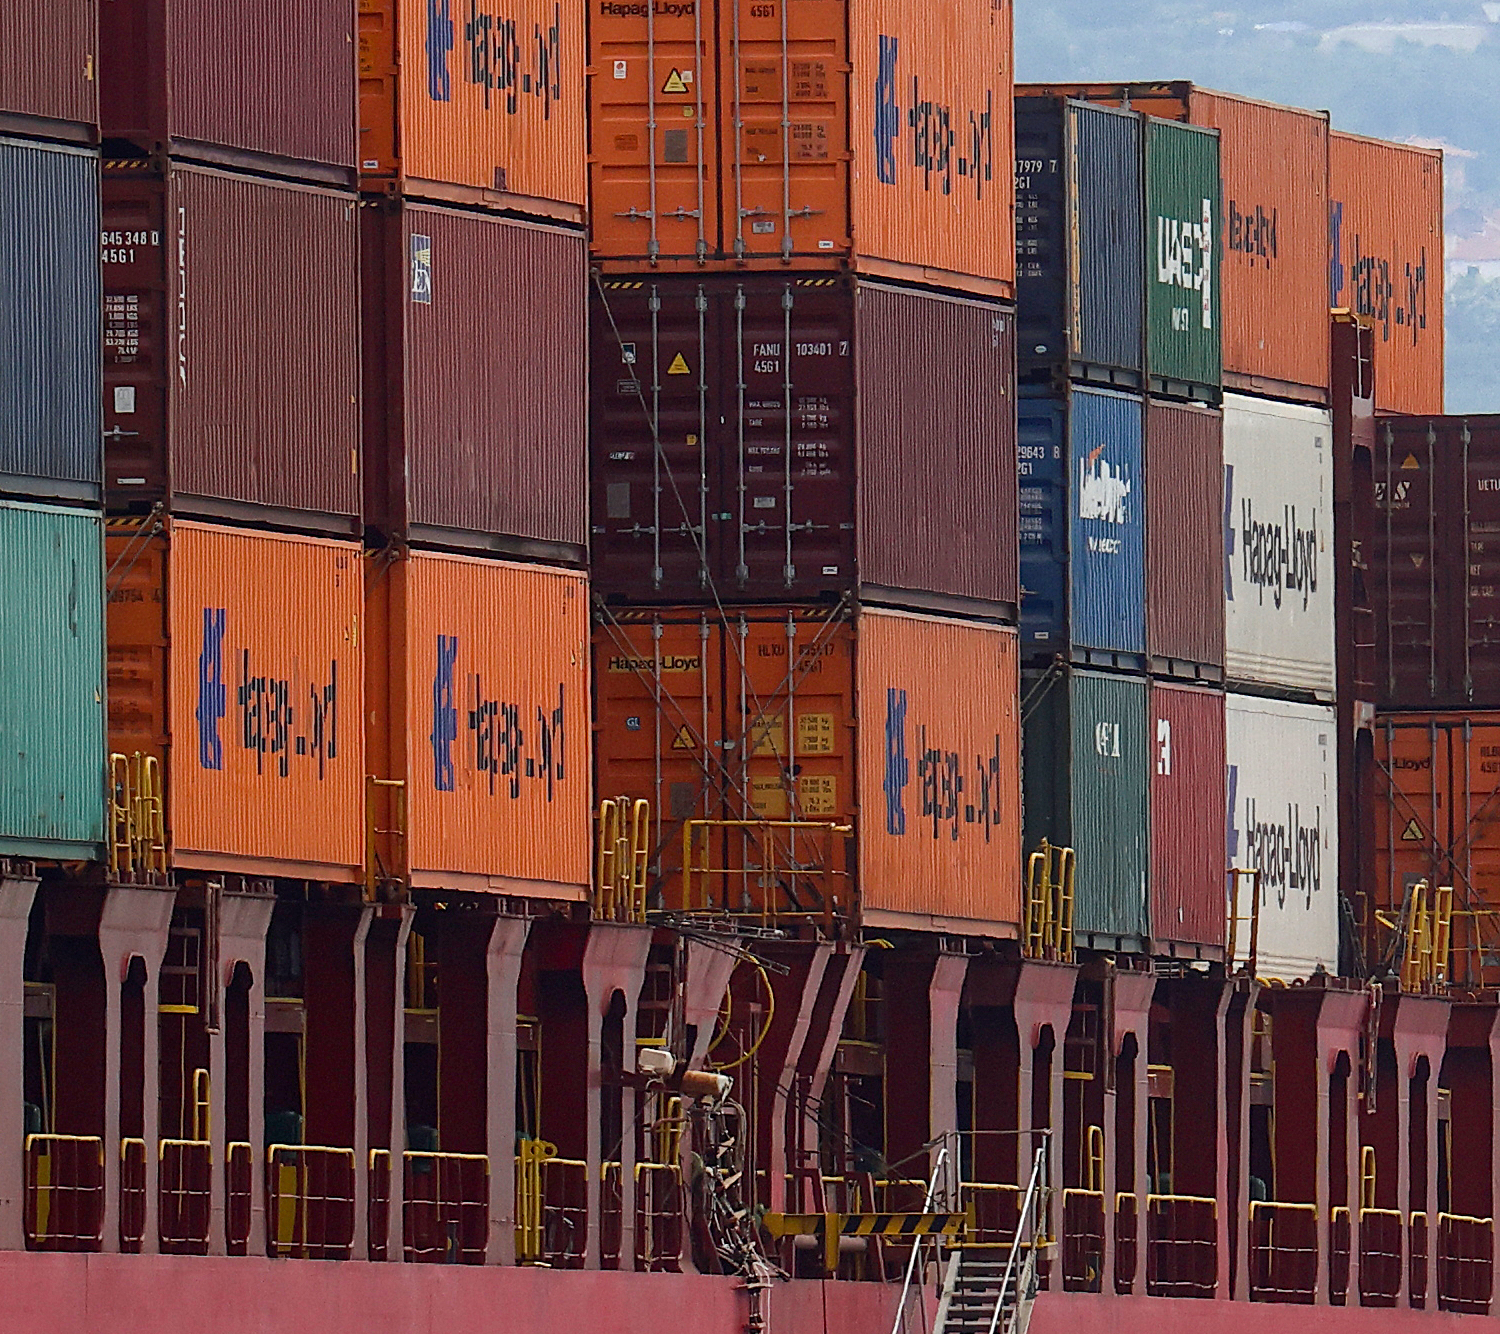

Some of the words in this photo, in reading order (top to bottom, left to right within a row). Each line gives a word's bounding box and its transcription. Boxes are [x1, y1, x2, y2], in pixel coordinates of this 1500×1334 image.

[600, 1, 696, 18] Hapag-Lloyd
[1014, 159, 1043, 173] 7979
[101, 231, 123, 246] 645
[125, 231, 148, 246] 348
[101, 249, 135, 264] 45G1
[753, 343, 781, 357] FANU
[795, 342, 833, 356] 103401
[753, 360, 780, 374] 45G1
[1241, 498, 1318, 612] Hapag-Lloyd
[608, 655, 701, 672] Hapag-Lloyd
[1381, 757, 1431, 771] -Lloyd
[1246, 796, 1321, 910] Hapag-Lloyd
